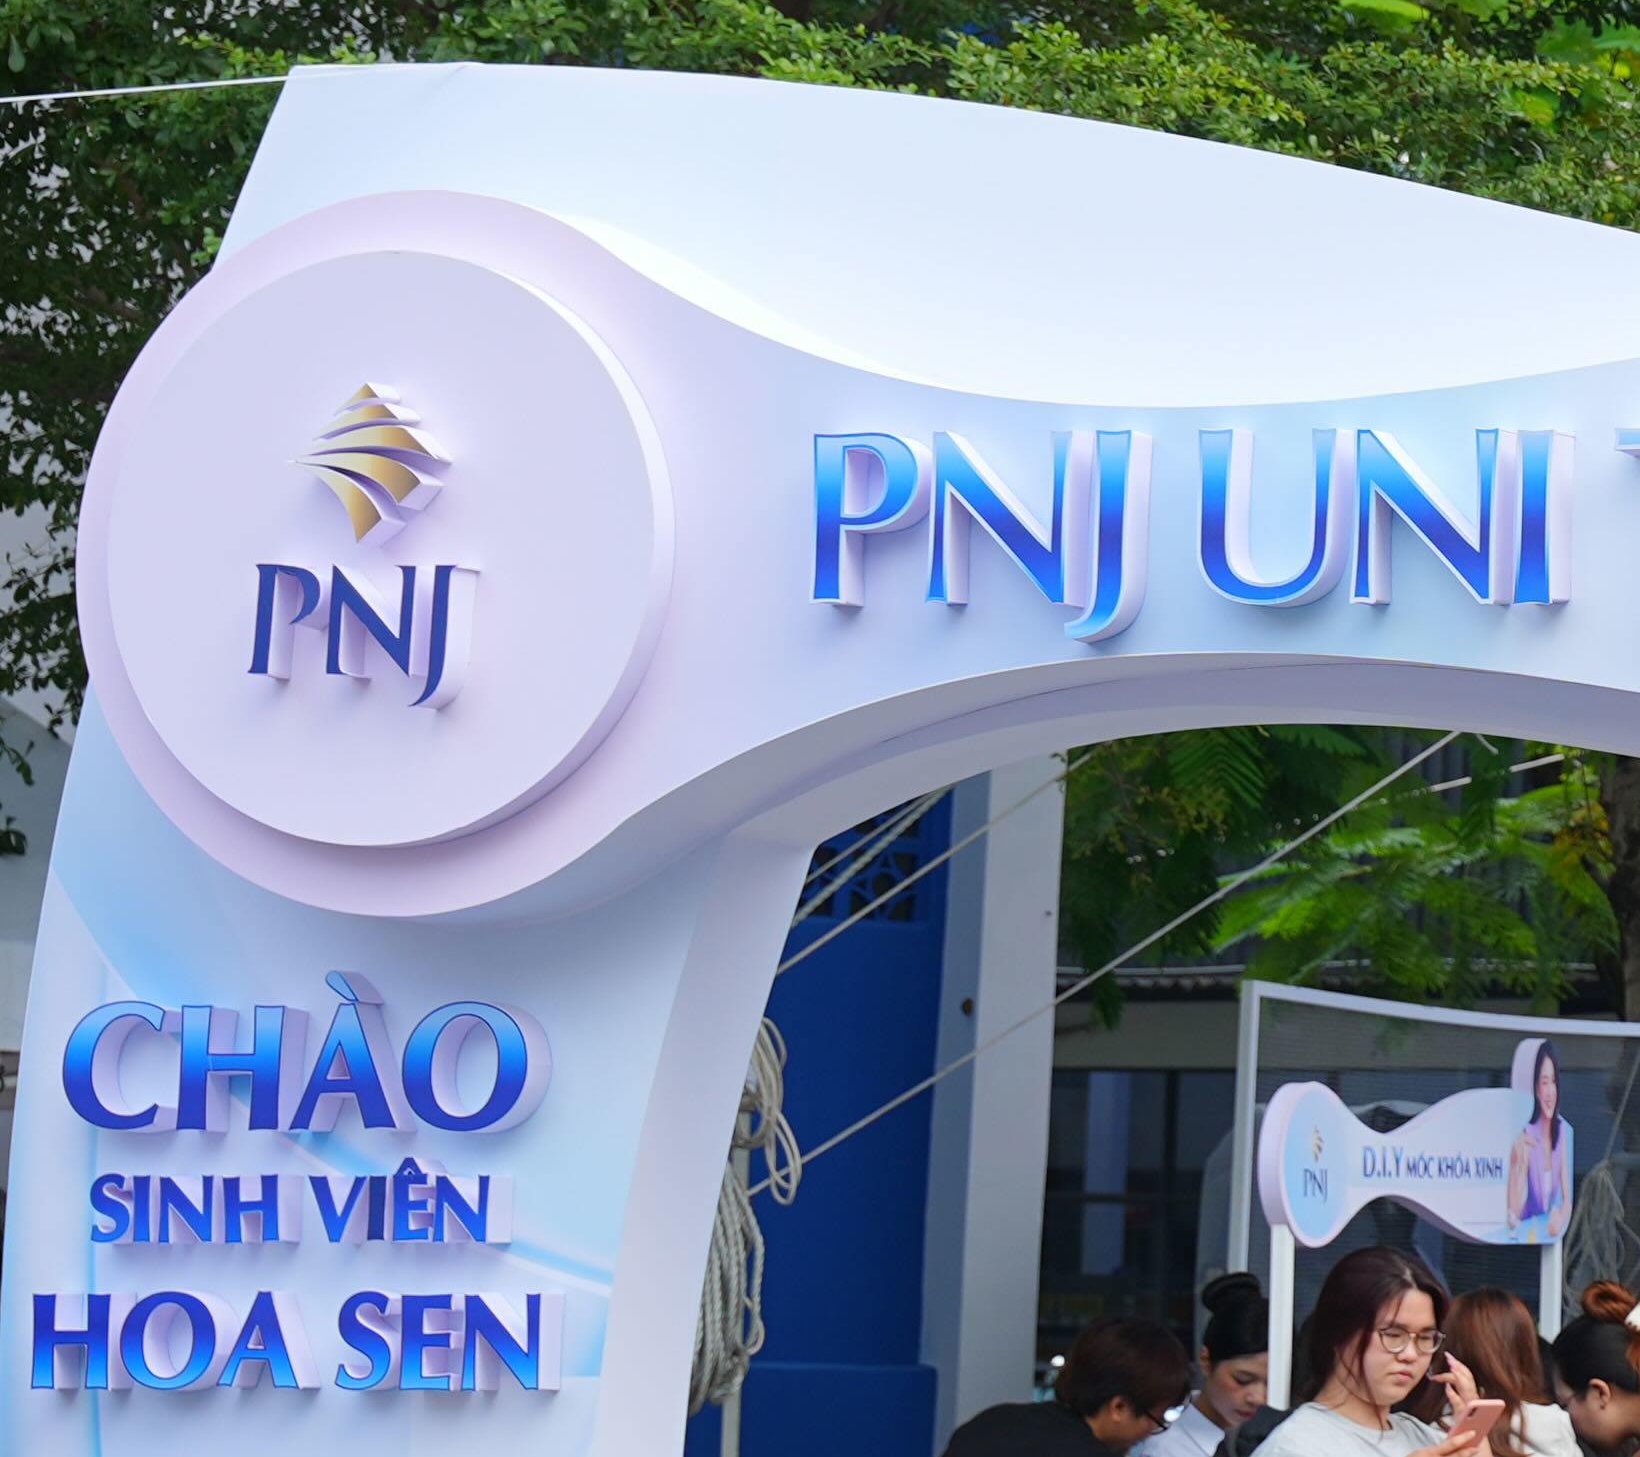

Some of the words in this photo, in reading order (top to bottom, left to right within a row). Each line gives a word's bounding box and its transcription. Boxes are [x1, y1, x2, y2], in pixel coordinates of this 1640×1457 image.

[810, 428, 1140, 642] PNJ
[1199, 428, 1560, 607] UNI
[247, 562, 464, 710] PNJ
[62, 970, 540, 1134] CHÀO
[89, 1172, 282, 1243] SINH
[310, 1156, 494, 1243] VIÊN
[1303, 1168, 1328, 1202] PNJ
[1362, 1146, 1404, 1179] D.I.Y
[1406, 1152, 1434, 1179] MÓC
[1438, 1152, 1471, 1179] KHÓA
[1474, 1156, 1504, 1180] XINH
[30, 1290, 305, 1392] HOA
[334, 1289, 545, 1392] SEN
